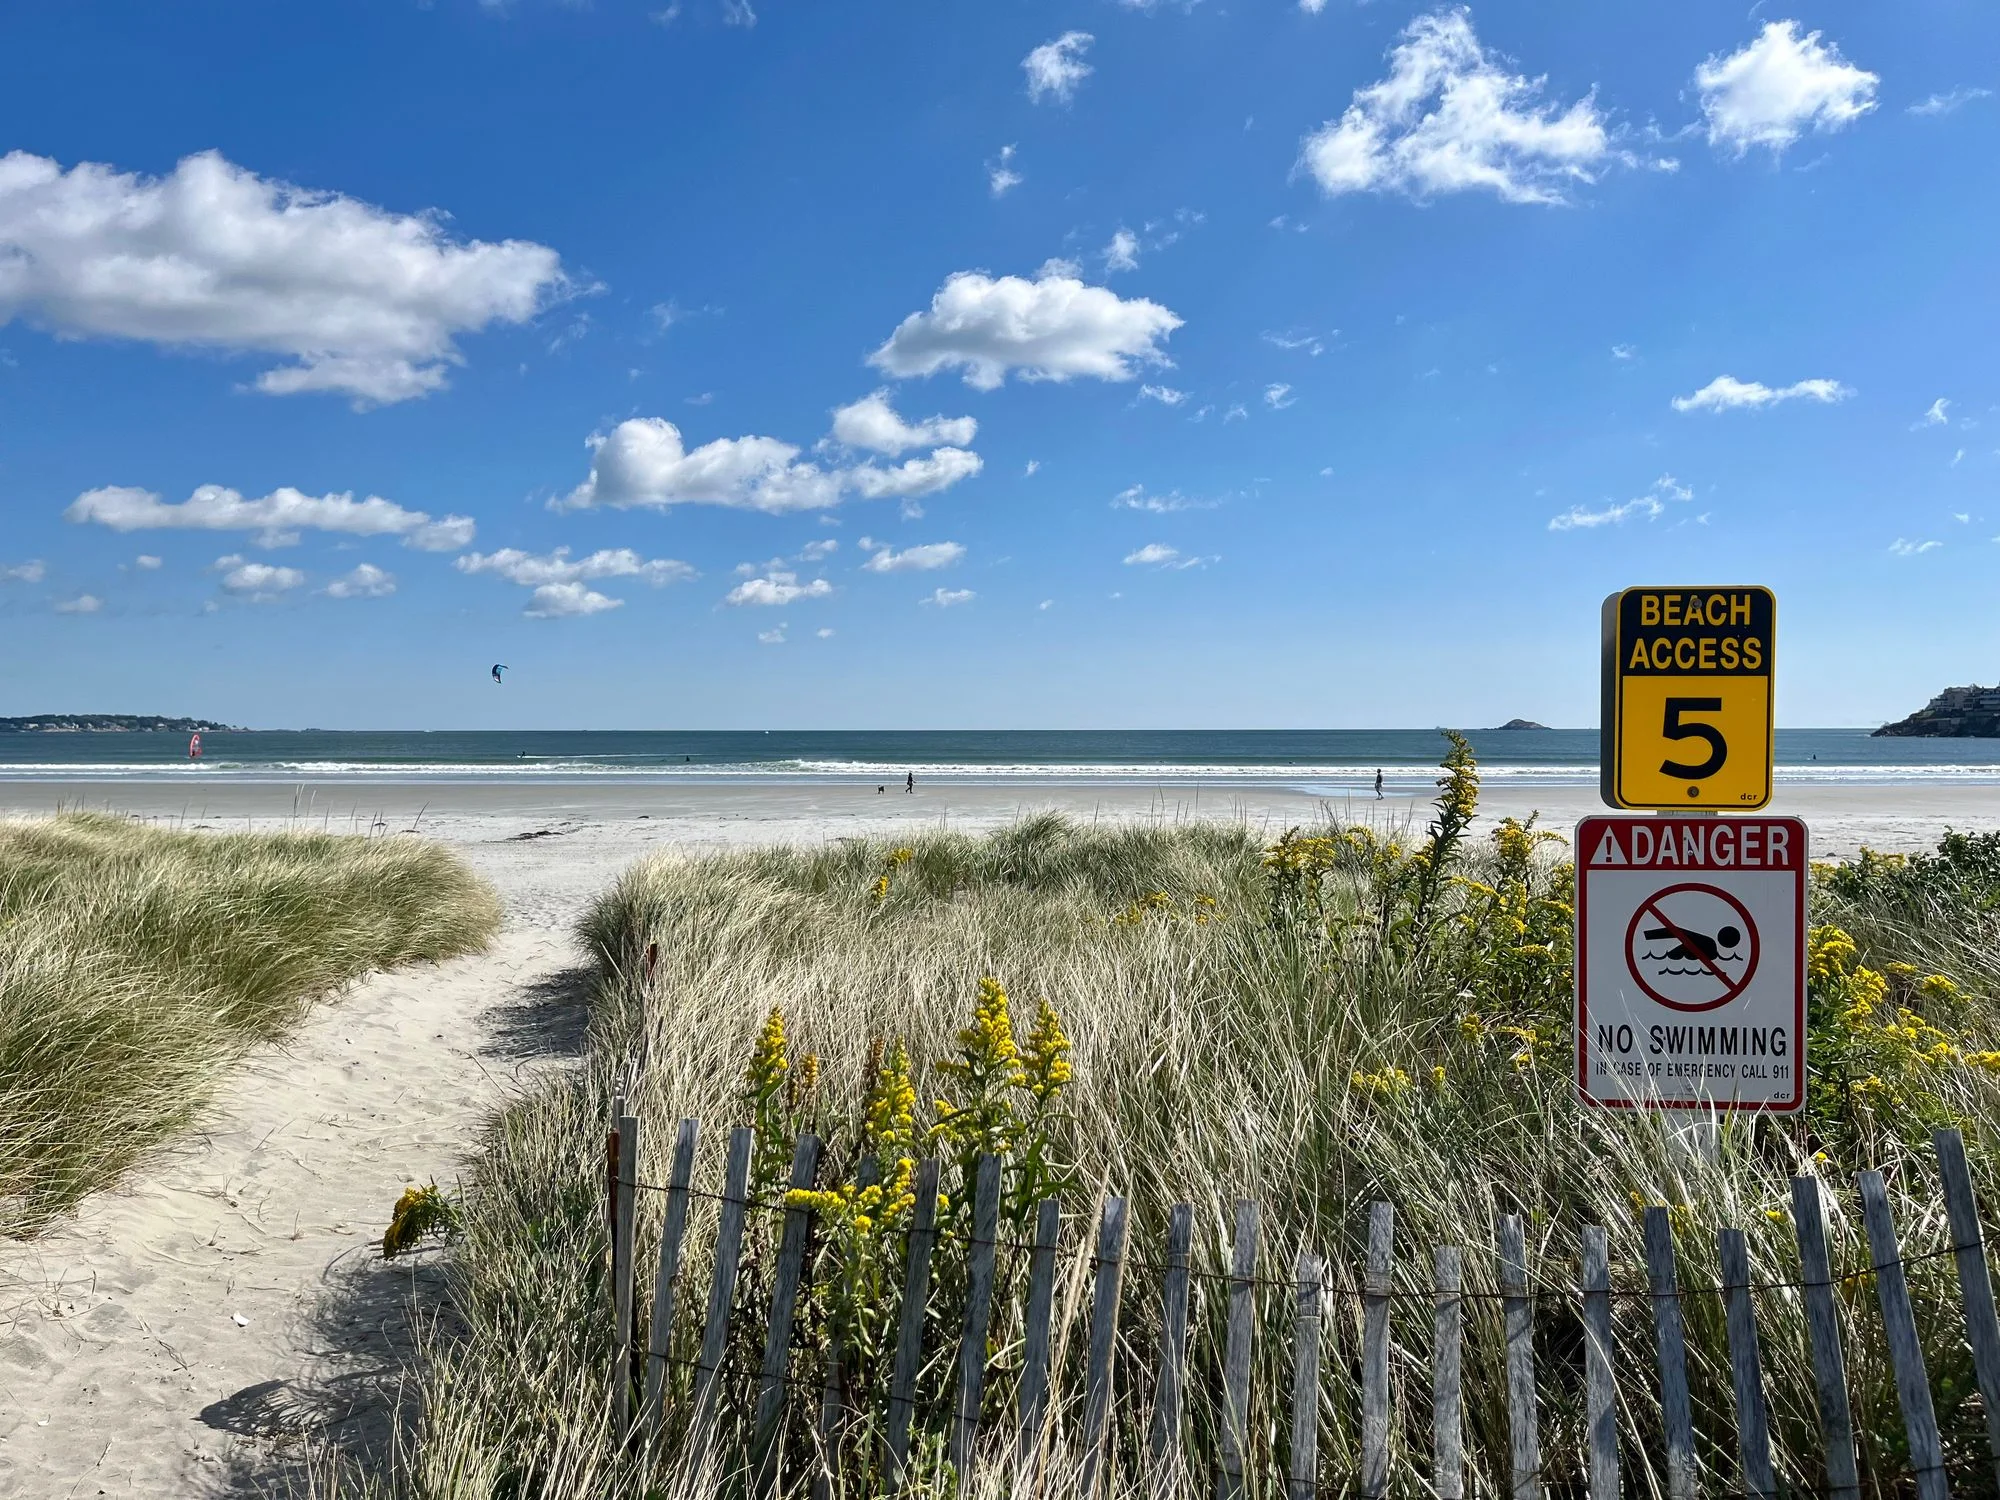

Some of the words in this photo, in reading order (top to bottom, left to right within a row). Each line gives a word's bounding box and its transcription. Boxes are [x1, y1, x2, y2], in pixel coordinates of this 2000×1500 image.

[1641, 594, 1751, 626] BEACH
[1629, 637, 1762, 670] ACCESS
[1659, 697, 1728, 780] 5
[1740, 793, 1757, 801] dcr
[1631, 824, 1789, 867] DANGER
[1599, 1024, 1633, 1053] NO
[1649, 1025, 1787, 1057] SWIMMING
[1596, 1061, 1607, 1076] IN
[1614, 1061, 1641, 1076] CASE
[1648, 1063, 1662, 1077] OF
[1667, 1063, 1736, 1078] EMERGENCY
[1741, 1064, 1768, 1079] CALL
[1773, 1064, 1789, 1079] 911
[1773, 1091, 1790, 1099] dcr
